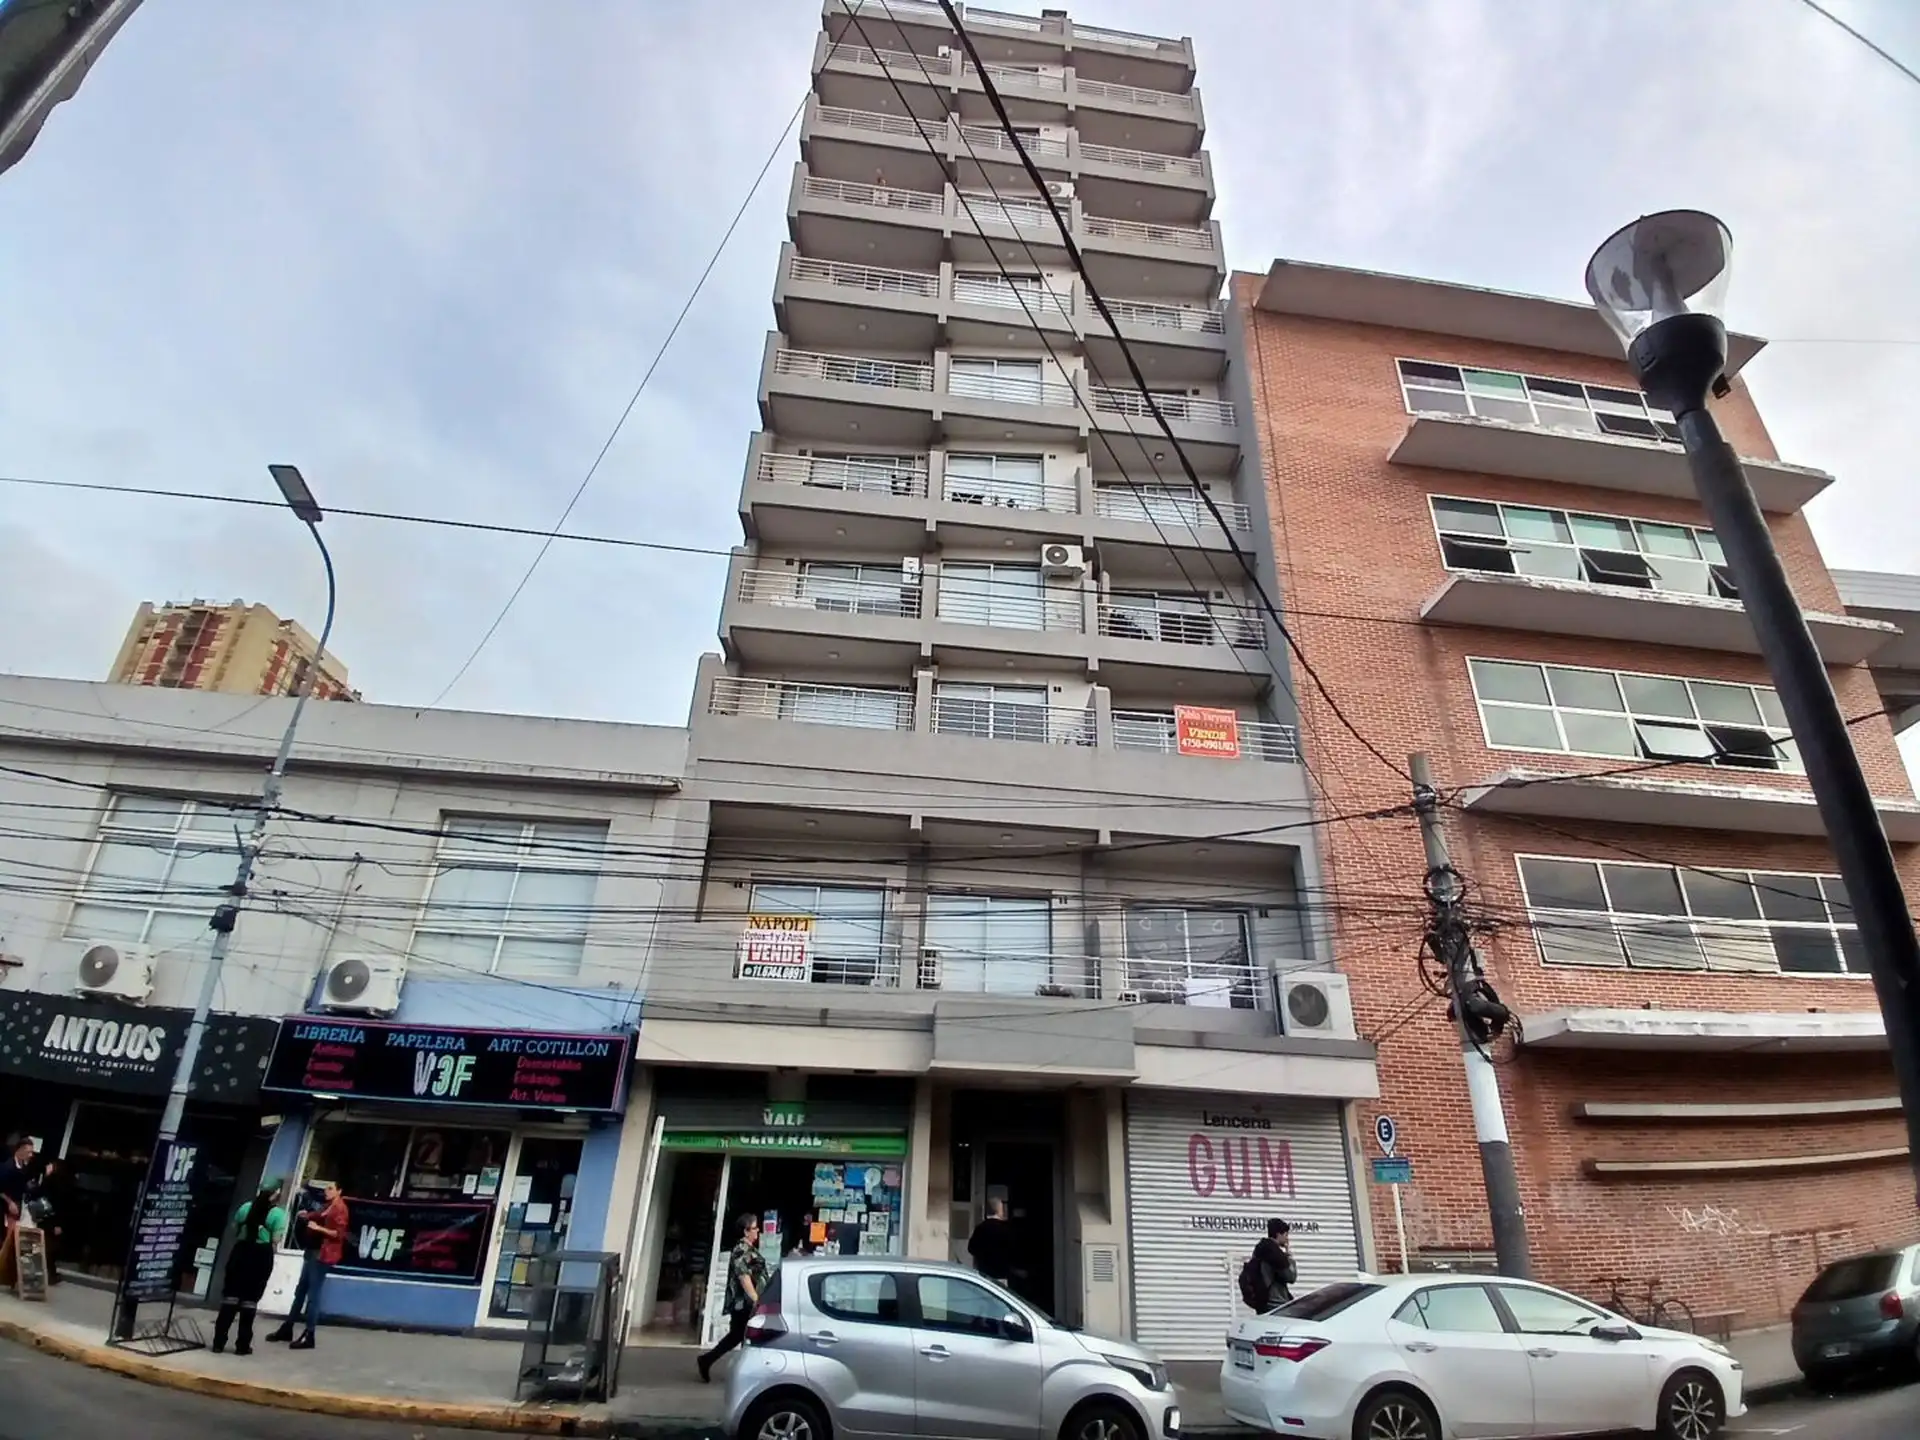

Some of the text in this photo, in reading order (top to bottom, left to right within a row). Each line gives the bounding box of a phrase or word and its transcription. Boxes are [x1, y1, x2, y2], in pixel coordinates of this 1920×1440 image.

[1188, 727, 1227, 740] VENDE
[749, 916, 808, 931] NAPOLI
[750, 943, 803, 963] VENDE
[43, 1014, 166, 1062] ANTOJOS
[385, 1032, 466, 1051] PAPELERA
[487, 1038, 522, 1053] ART.
[413, 1050, 477, 1097] V3F
[1380, 1121, 1390, 1139] E
[1188, 1133, 1296, 1200] GUM
[358, 1224, 406, 1262] V3F
